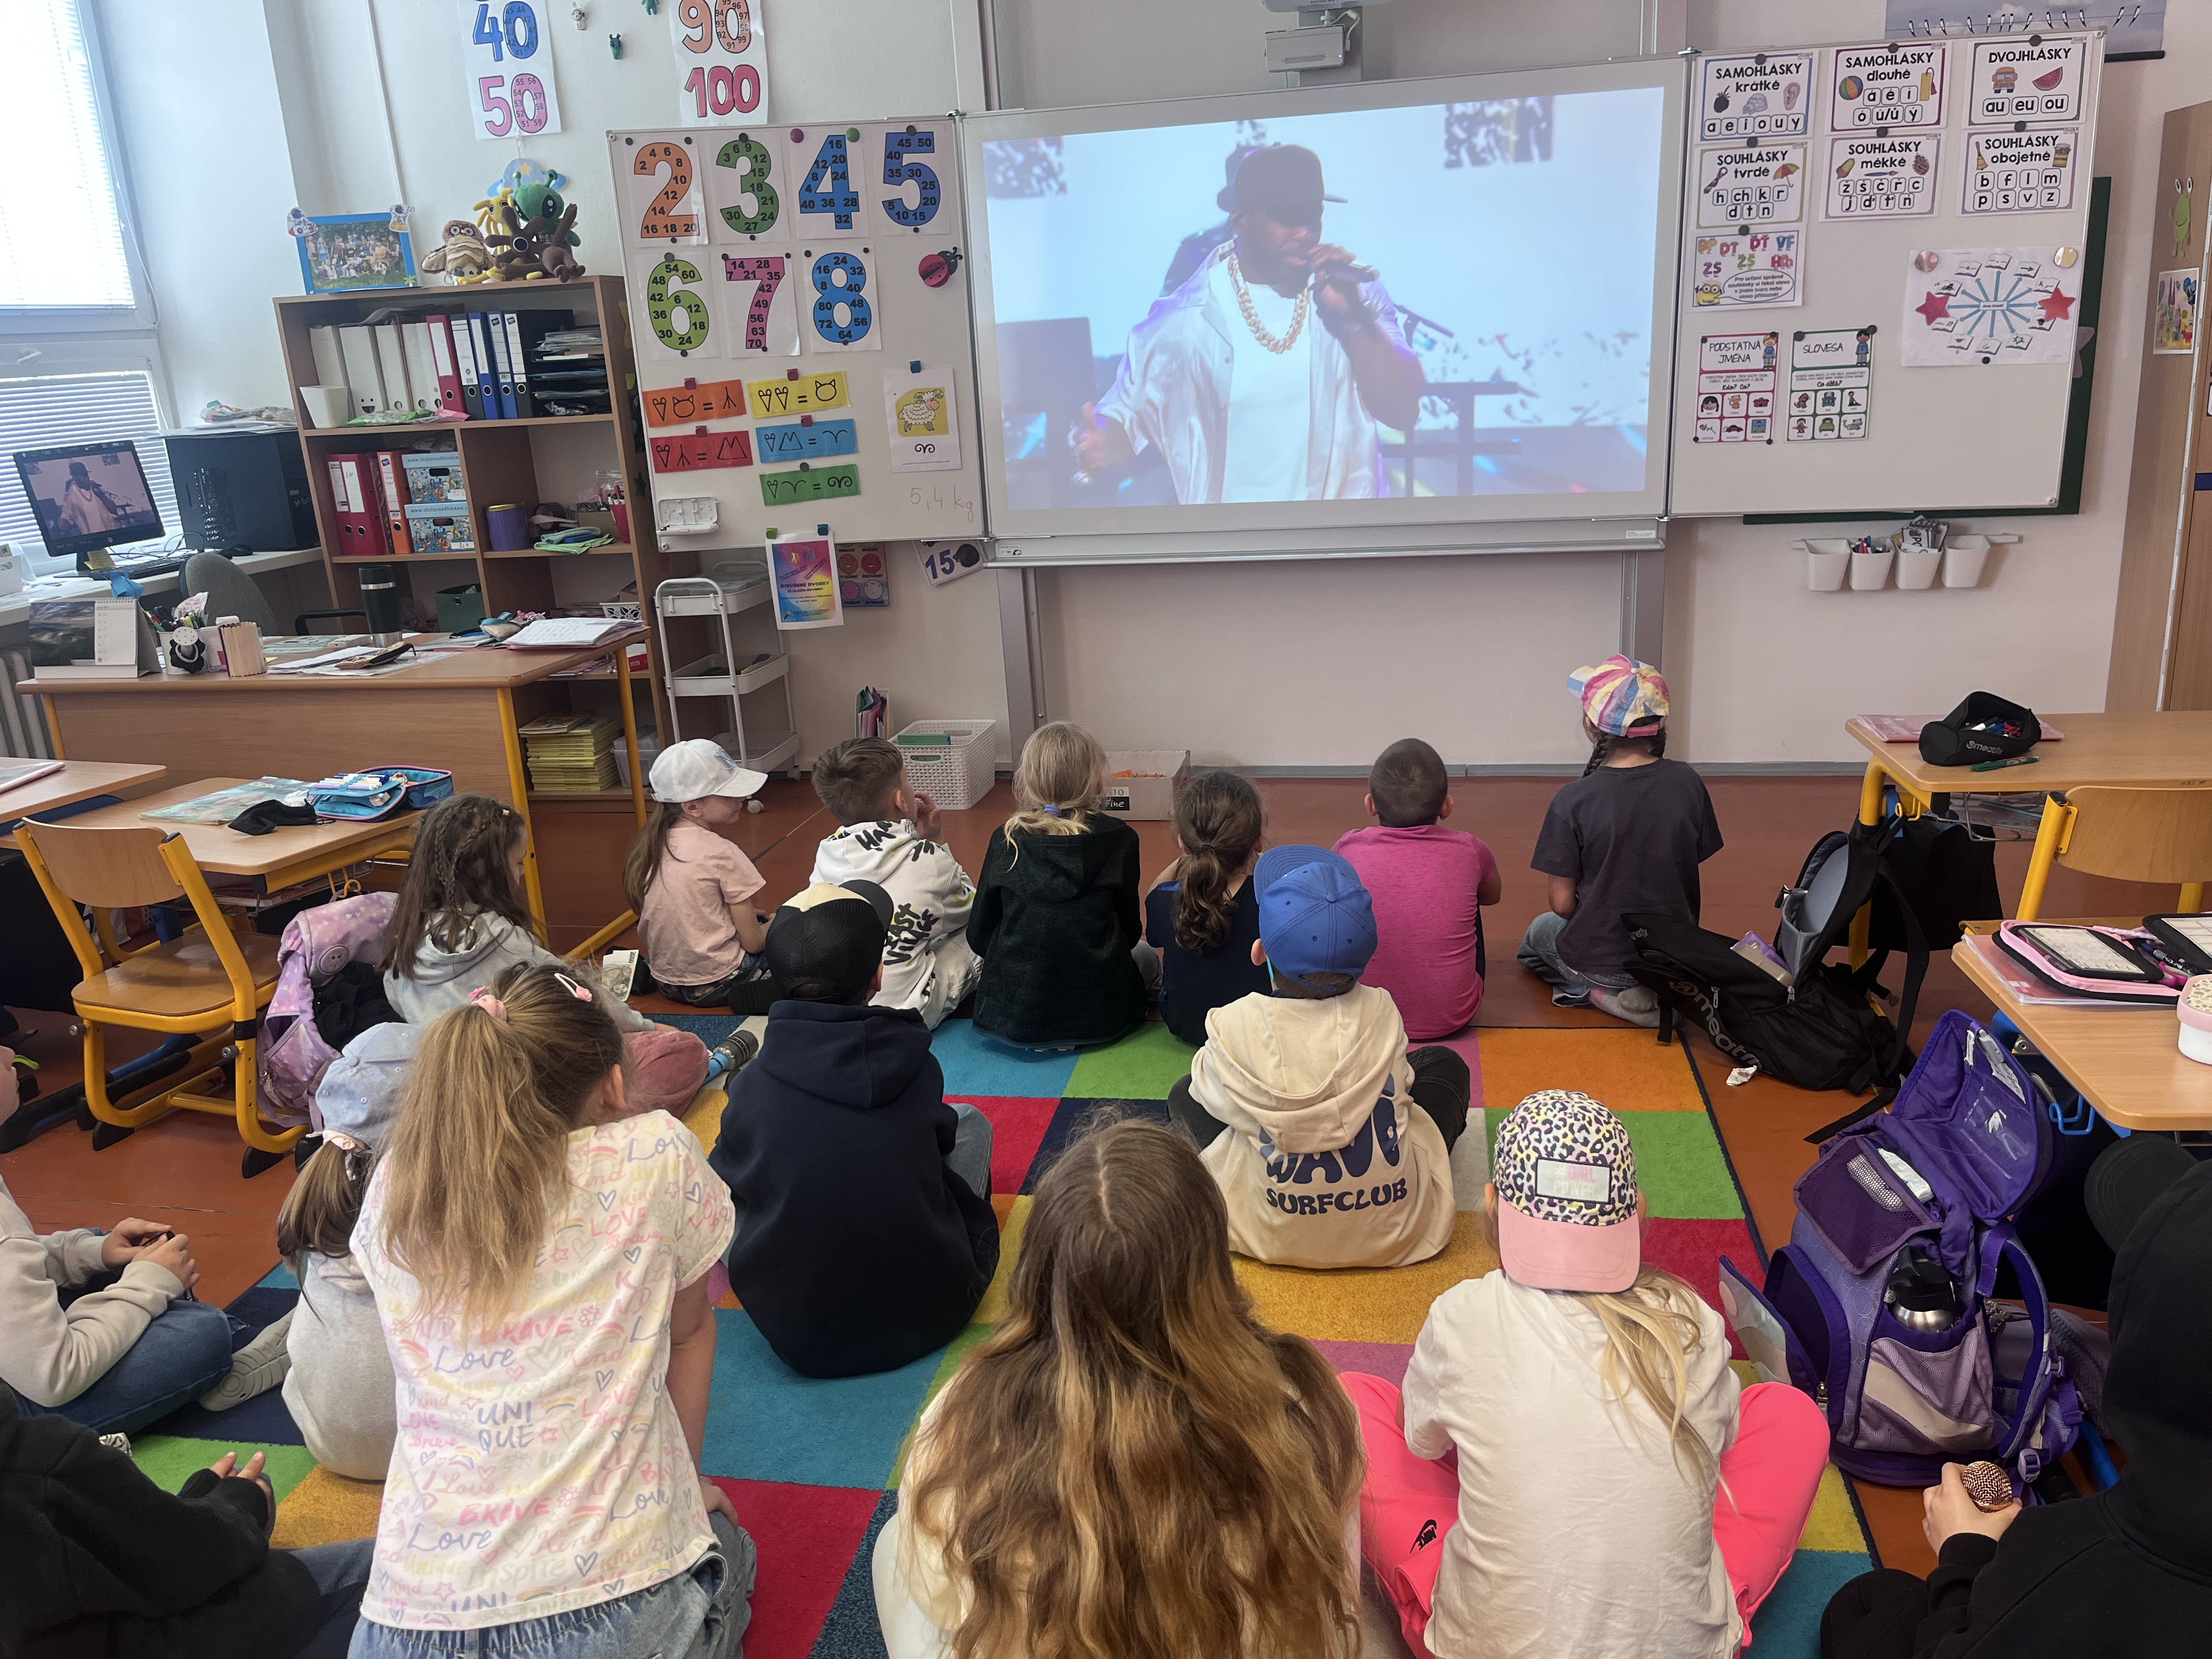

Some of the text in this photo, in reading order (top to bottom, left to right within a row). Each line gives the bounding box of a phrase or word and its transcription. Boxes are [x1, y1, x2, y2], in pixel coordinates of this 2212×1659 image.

[474, 1, 538, 61] 40
[679, 0, 752, 54] 90
[1846, 52, 1934, 67] SAMOHLÁSKY
[1989, 48, 2071, 63] DVOJHLÁSKY
[1716, 63, 1802, 79] SAMOHLÁSKY
[1867, 69, 1910, 81] dlouhé
[685, 64, 760, 118] 100
[1735, 80, 1780, 92] krátké
[1867, 87, 1910, 101] á é í
[478, 73, 548, 137] 50
[1986, 99, 2064, 112] au eu ou
[1858, 110, 1865, 121] ó
[1909, 107, 1917, 121] ý
[1707, 118, 1799, 132] a e i o u y
[733, 143, 752, 153] 6 9
[1848, 140, 1921, 155] SOUHLÁSKY
[1985, 135, 2058, 150] SOUHLÁSKY
[649, 147, 671, 157] 4 6
[724, 153, 731, 162] 3
[1717, 150, 1788, 165] SOUHLÁSKY
[1991, 151, 2051, 165] obojetné
[676, 158, 683, 167] 8
[753, 154, 767, 163] 12
[640, 161, 647, 170] 2
[751, 168, 765, 177] 15
[1734, 166, 1770, 178] tvrdé
[673, 175, 687, 184] 10
[799, 135, 860, 229] 4
[882, 132, 940, 226] 5
[1980, 175, 1989, 187] b
[2005, 174, 2012, 186] f
[2044, 174, 2057, 184] m
[634, 142, 700, 238] 2
[716, 139, 779, 234] 3
[749, 183, 763, 192] 18
[1843, 178, 1920, 193] ž š č ř c
[664, 190, 678, 200] 12
[761, 196, 774, 205] 21
[1716, 189, 1784, 204] h ch k r
[1978, 192, 2055, 208] p s v z
[1845, 195, 1911, 211] j ď ť ň
[652, 207, 665, 216] 14
[726, 211, 740, 220] 30
[760, 212, 775, 221] 24
[1729, 205, 1770, 218] d t n
[644, 223, 697, 234] 16 18 20
[744, 222, 758, 231] 27
[1776, 235, 1795, 251] VF
[665, 264, 679, 273] 54
[731, 261, 745, 269] 14
[756, 260, 770, 268] 28
[652, 276, 665, 285] 48
[681, 270, 695, 279] 60
[727, 270, 757, 280] 7 21
[759, 284, 772, 292] 42
[650, 293, 663, 302] 42
[725, 257, 785, 348] 7
[812, 252, 872, 343] 8
[647, 259, 709, 350] 6
[687, 304, 701, 313] 12
[755, 300, 768, 308] 49
[653, 311, 667, 319] 36
[750, 314, 764, 323] 56
[692, 321, 706, 330] 18
[751, 327, 765, 335] 63
[658, 330, 673, 338] 30
[678, 336, 692, 345] 24
[748, 339, 761, 347] 70
[1803, 343, 1843, 353] SLOVESA
[1718, 353, 1751, 363] JMÉNA
[954, 486, 974, 523] kg
[925, 549, 955, 579] 15
[1266, 1177, 1408, 1215] SURFCLUB
[590, 1206, 647, 1237] LOVE
[434, 1345, 516, 1373] Love
[478, 1401, 532, 1425] UNI
[478, 1424, 535, 1452] QUE
[407, 1522, 493, 1551] Love
